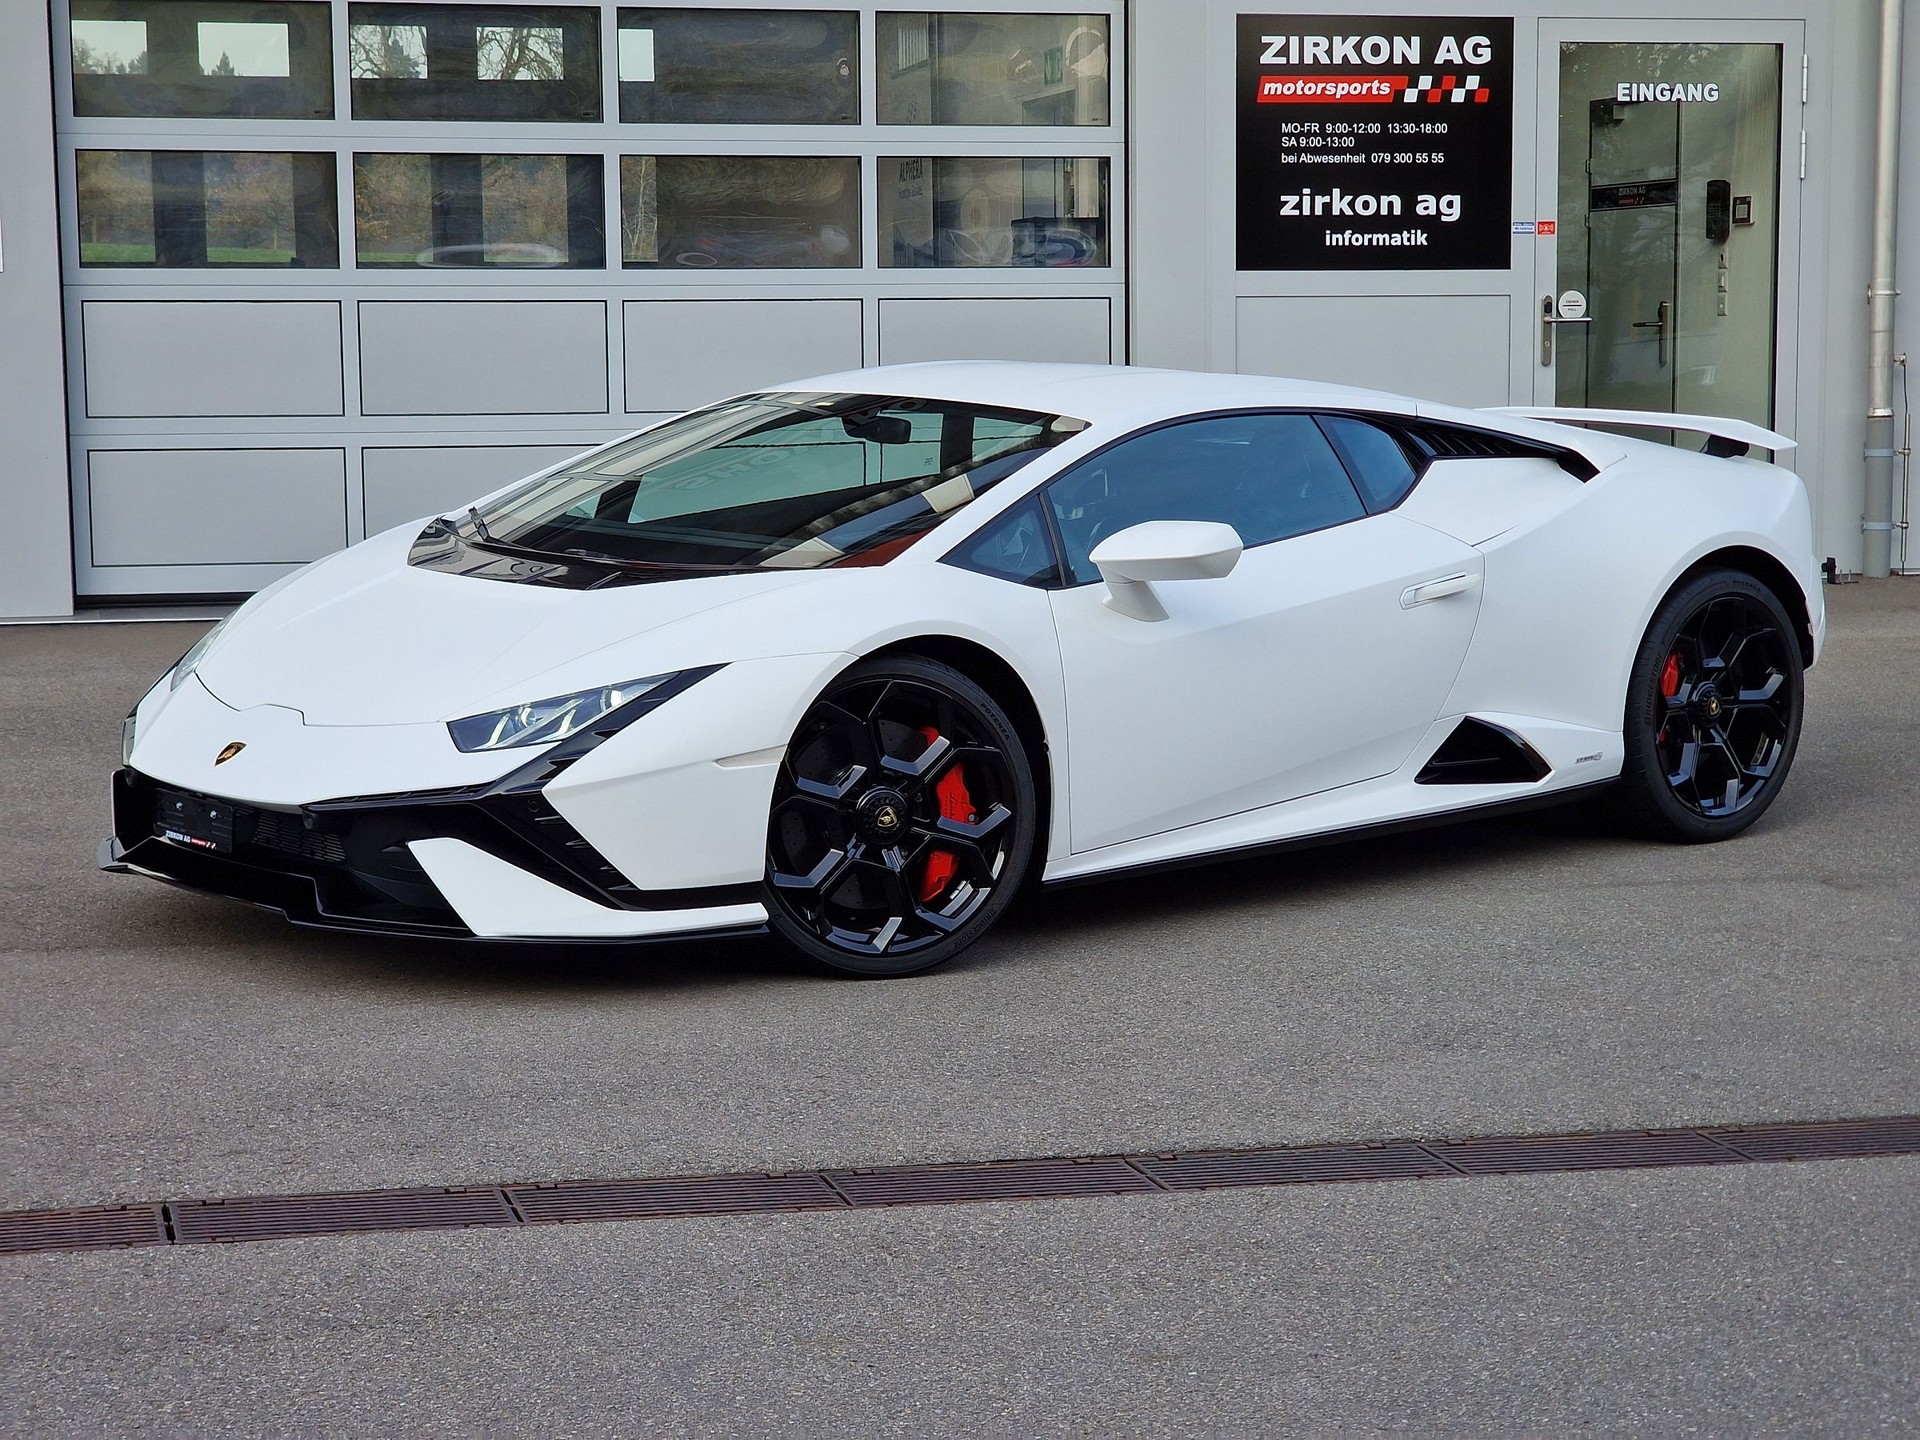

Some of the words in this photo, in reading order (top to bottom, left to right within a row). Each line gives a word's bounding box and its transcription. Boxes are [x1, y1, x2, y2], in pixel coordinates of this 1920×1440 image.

[1259, 35, 1421, 65] ZIRKON
[1434, 35, 1492, 65] AG
[1263, 79, 1391, 99] motorsports
[1617, 83, 1719, 102] EINGANG
[1281, 122, 1320, 134] MO-FR
[1325, 122, 1381, 134] 9:00-12:00
[1387, 122, 1448, 134] 13:30-18:00
[1281, 136, 1298, 147] SA
[1299, 136, 1355, 147] 9:00-13:00
[1281, 152, 1298, 164] bei
[1299, 152, 1366, 164] Abwesenheit
[1371, 152, 1391, 164] 079
[1393, 152, 1413, 164] 300
[1415, 152, 1429, 164] 55
[1431, 152, 1445, 164] 55
[1279, 187, 1402, 216] zirkon
[1415, 194, 1462, 222] ag
[1325, 229, 1428, 247] informatik
[980, 702, 1010, 741] POTENZA
